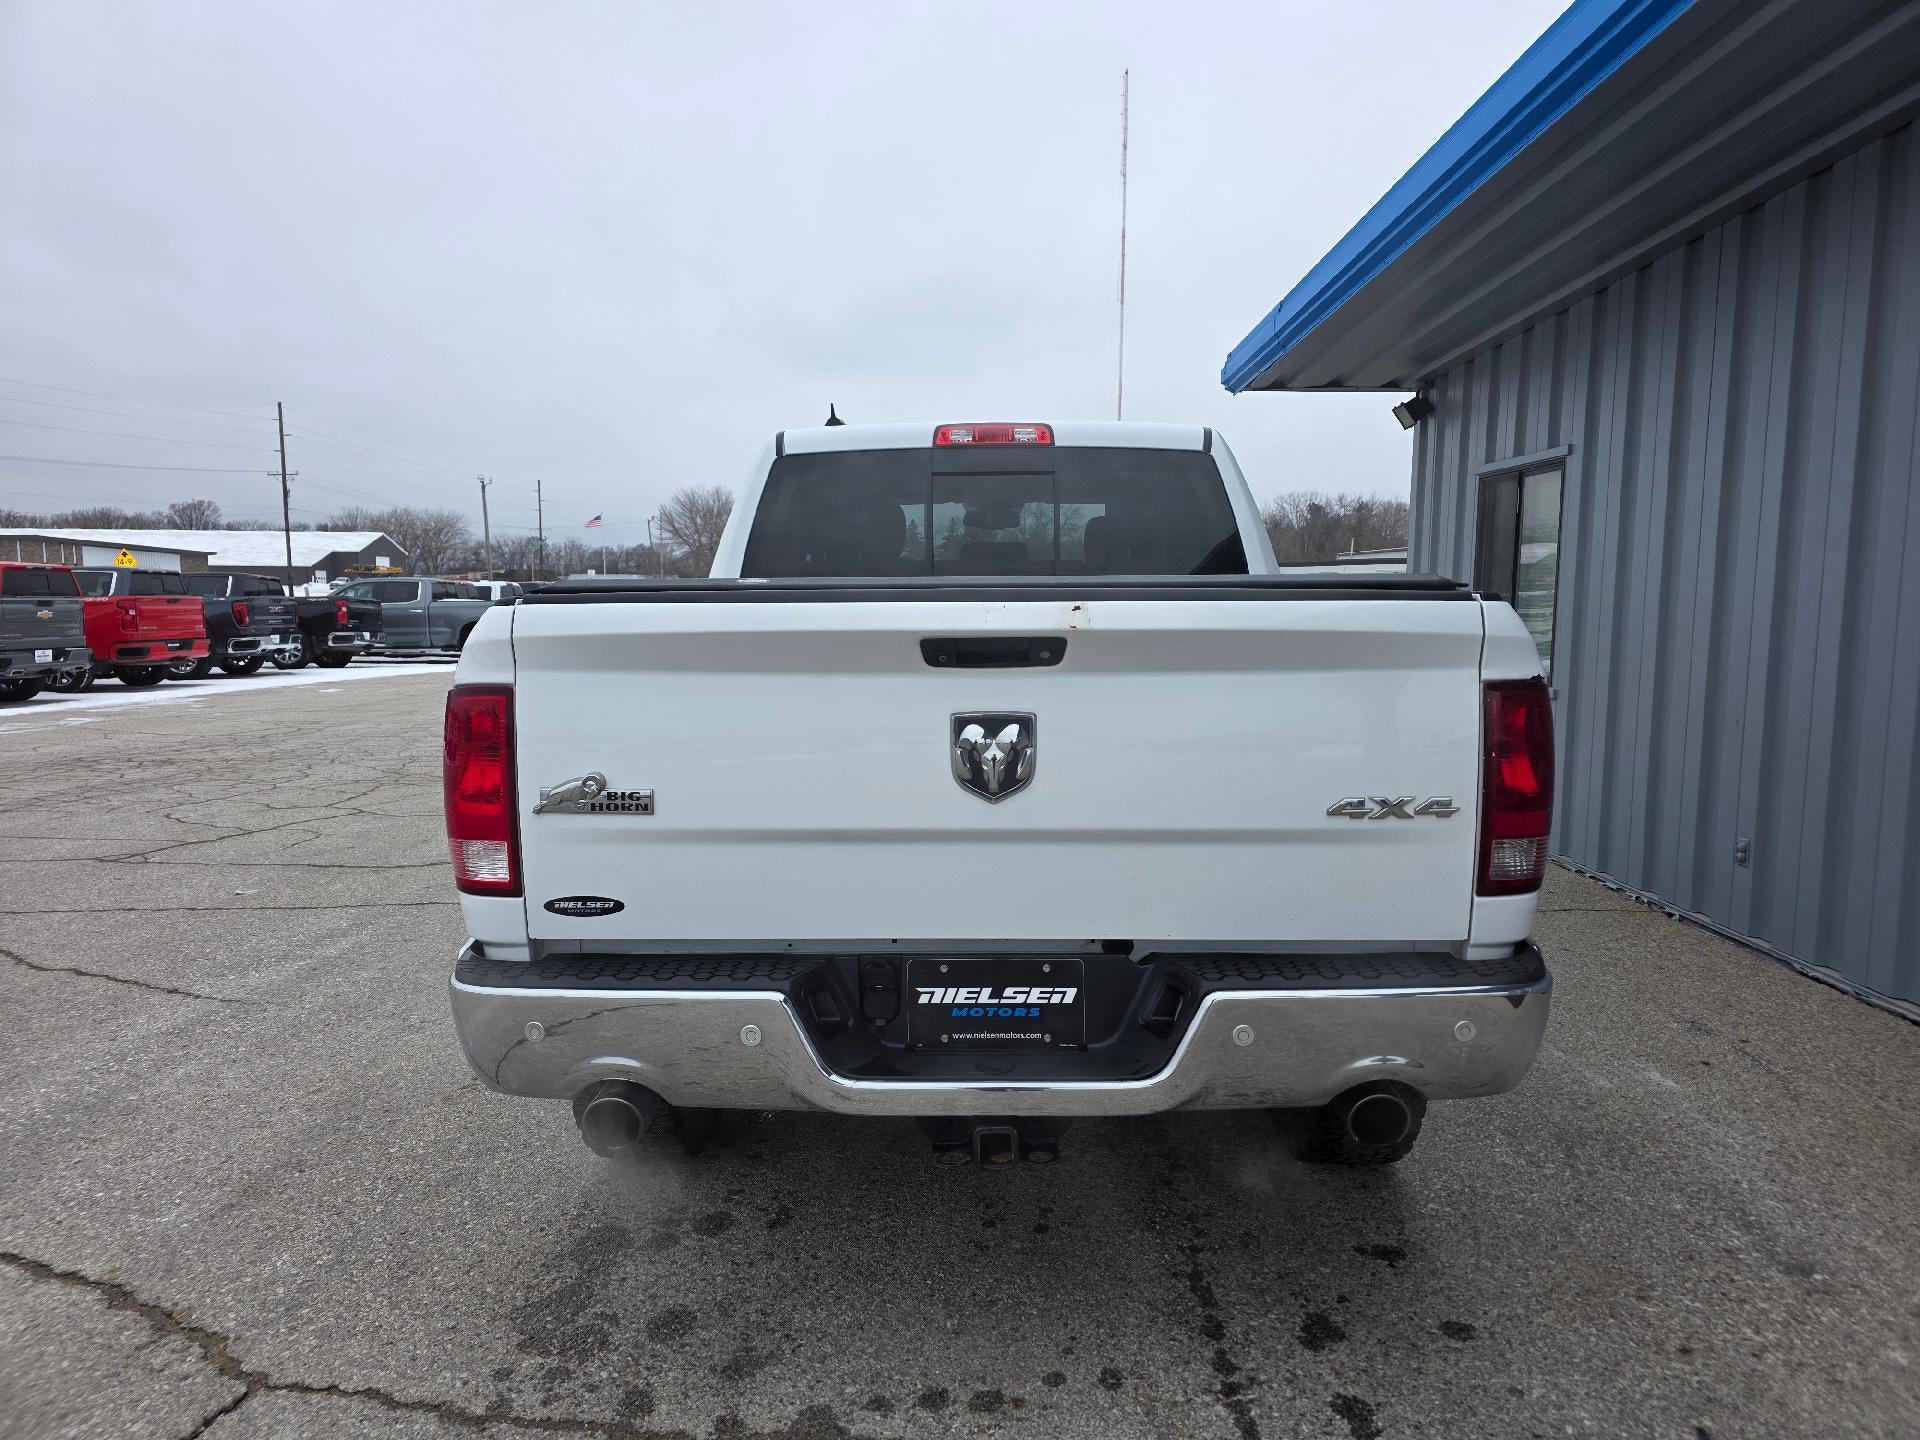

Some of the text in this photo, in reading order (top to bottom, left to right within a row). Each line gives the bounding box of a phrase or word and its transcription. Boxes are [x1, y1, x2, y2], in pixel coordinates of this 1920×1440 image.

[606, 791, 641, 801] BIG
[590, 802, 649, 812] HORN
[915, 986, 1078, 1004] NIELSEN
[951, 1007, 1041, 1017] MOTORS
[952, 1031, 1042, 1039] www.nielsenmotors.com
